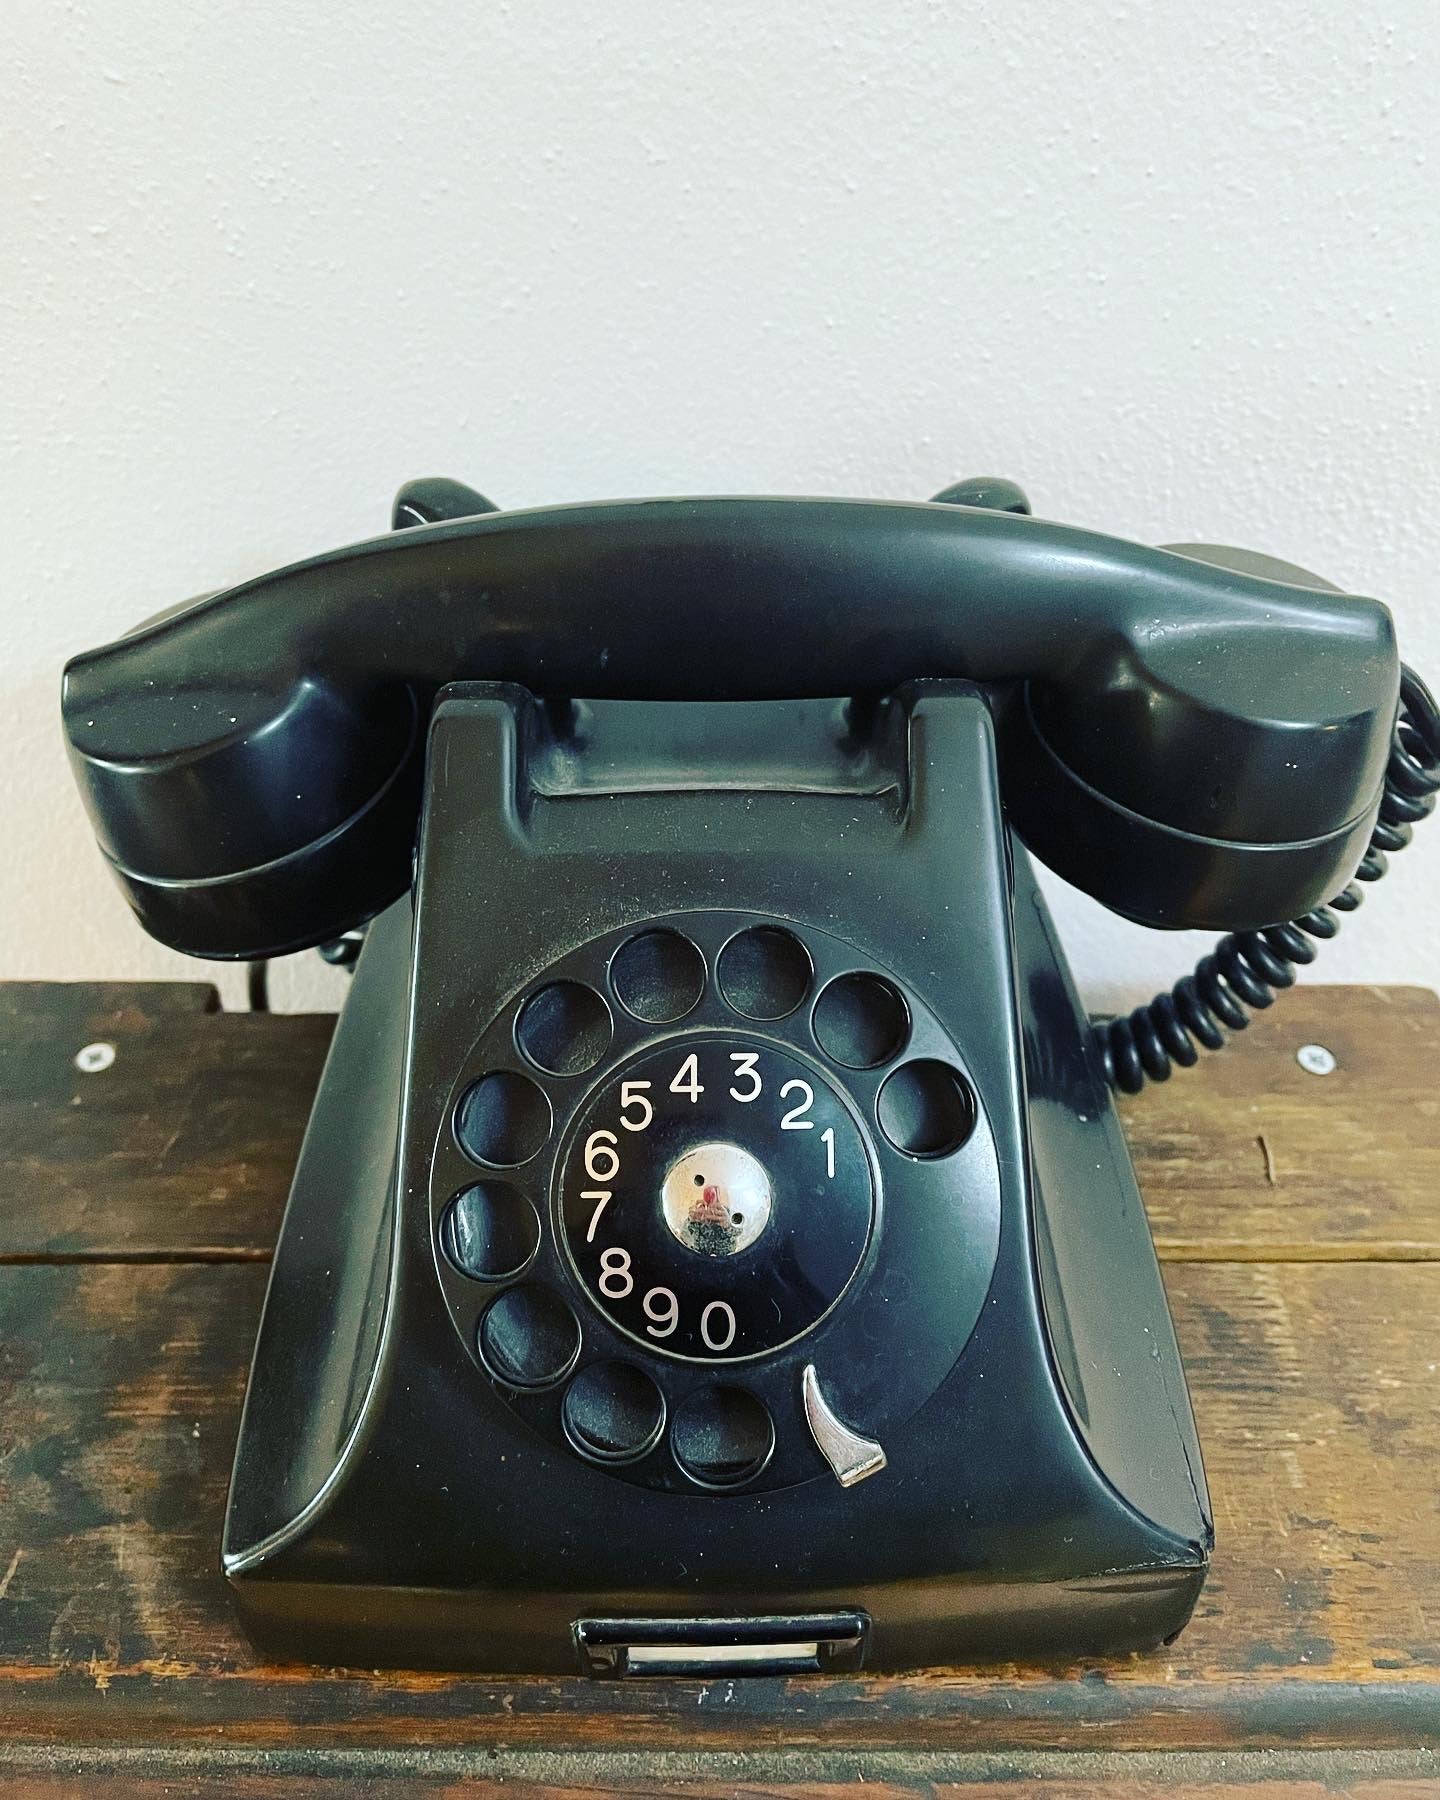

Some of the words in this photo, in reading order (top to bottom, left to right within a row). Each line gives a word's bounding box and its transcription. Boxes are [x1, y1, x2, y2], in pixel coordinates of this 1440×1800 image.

[668, 1053, 705, 1104] 4
[729, 1052, 763, 1103] 3
[619, 1080, 654, 1132] 5
[779, 1078, 815, 1130] 2
[584, 1129, 620, 1182] 6
[819, 1126, 836, 1179] 1
[579, 1190, 613, 1243] 7
[598, 1247, 634, 1299] 8
[642, 1286, 679, 1338] 9
[700, 1300, 736, 1351] 0
